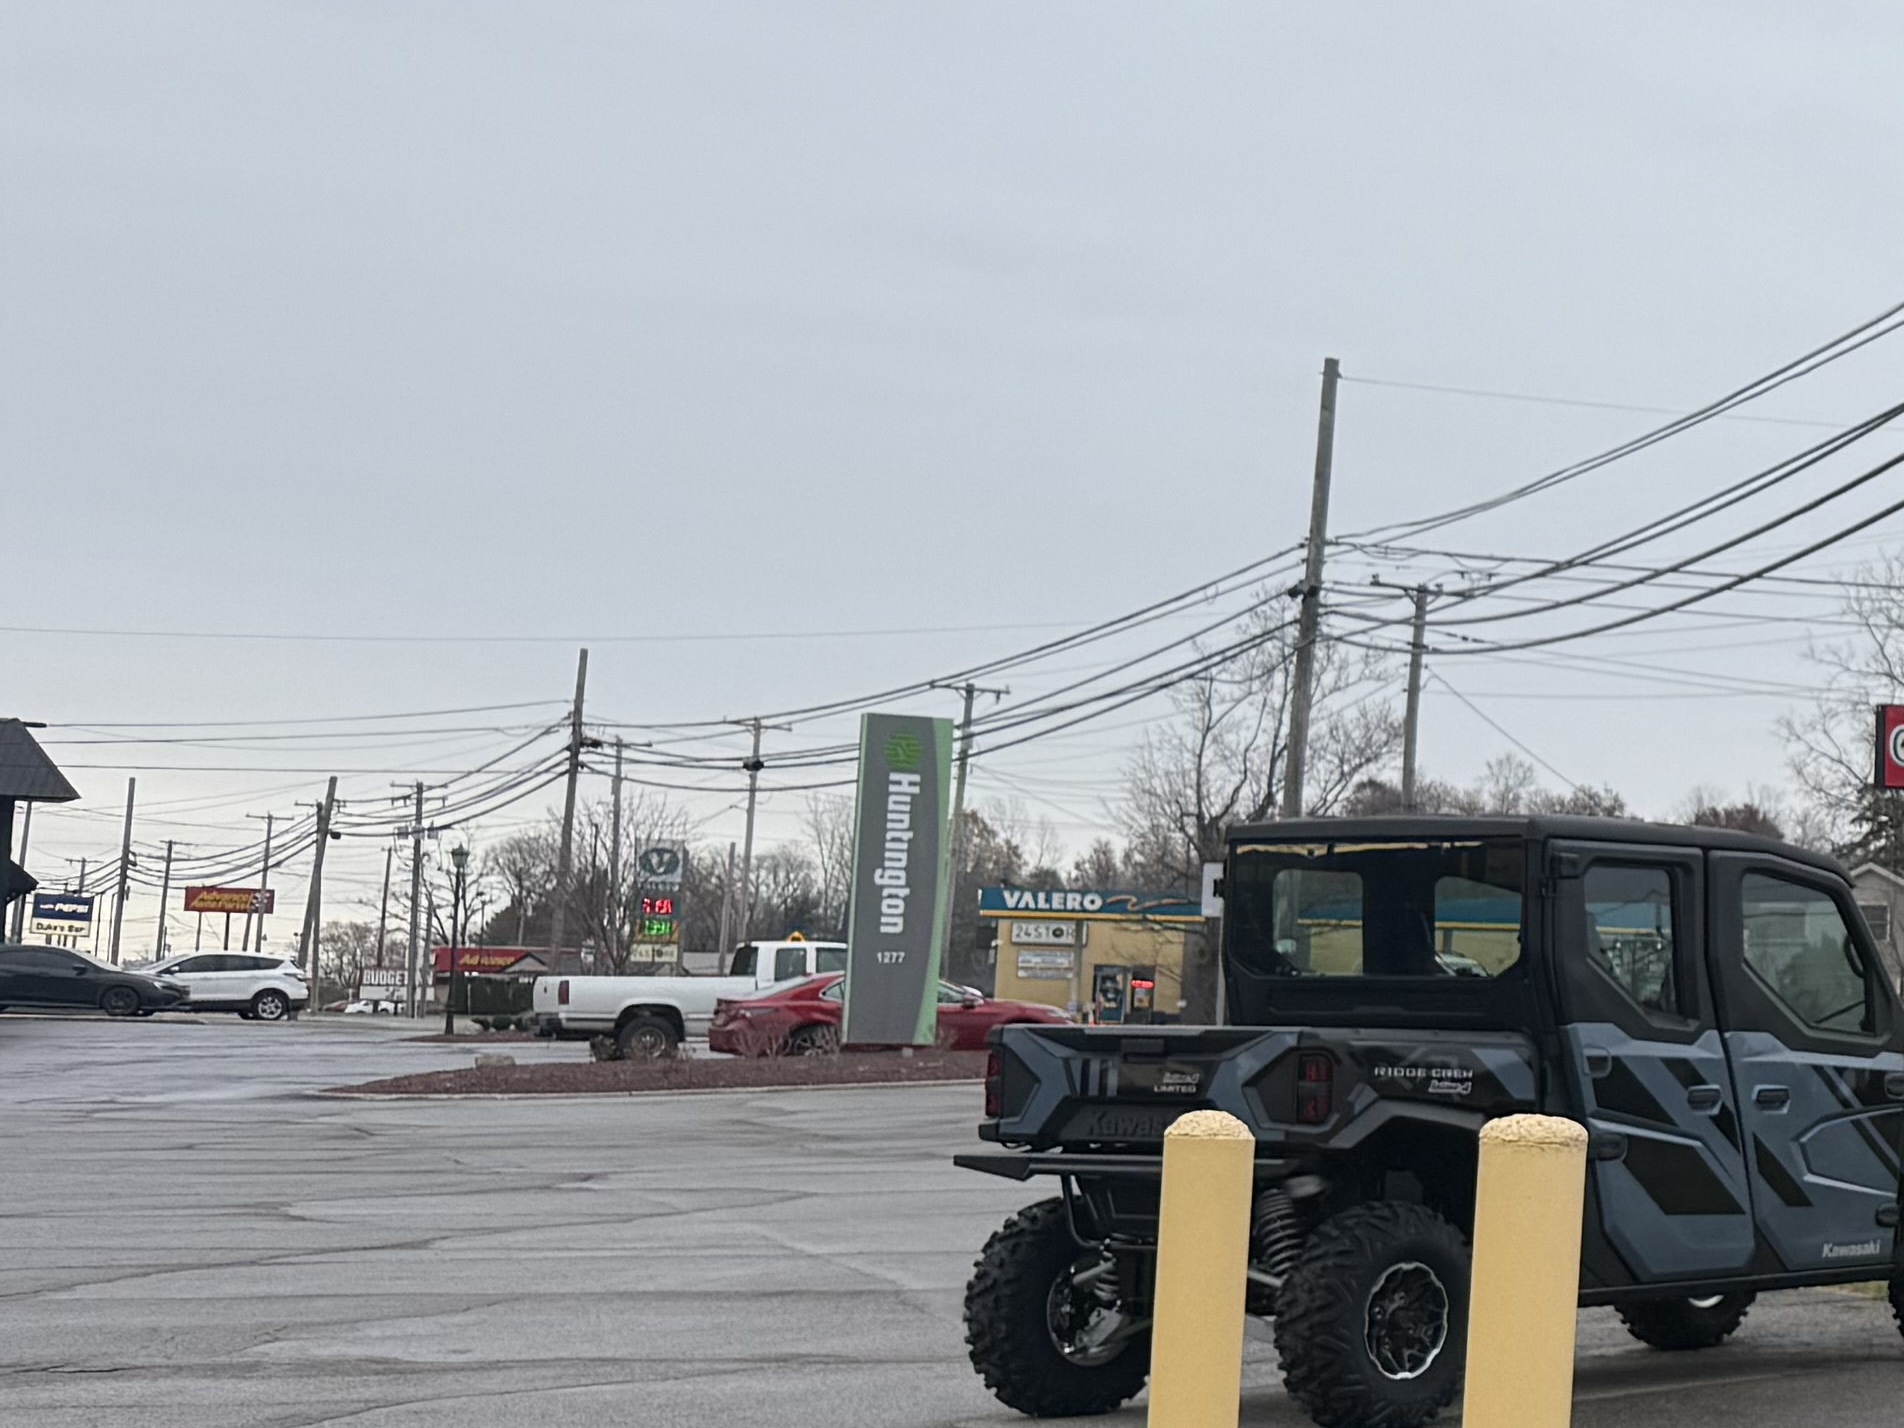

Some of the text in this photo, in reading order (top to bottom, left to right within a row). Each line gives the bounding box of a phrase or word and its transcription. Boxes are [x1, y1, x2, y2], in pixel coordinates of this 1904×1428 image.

[874, 772, 921, 934] Huntington
[1002, 890, 1103, 911] VALERO
[876, 951, 905, 963] 1277
[1154, 1084, 1197, 1092] LIMITED
[1822, 1239, 1881, 1258] Kawasaki
